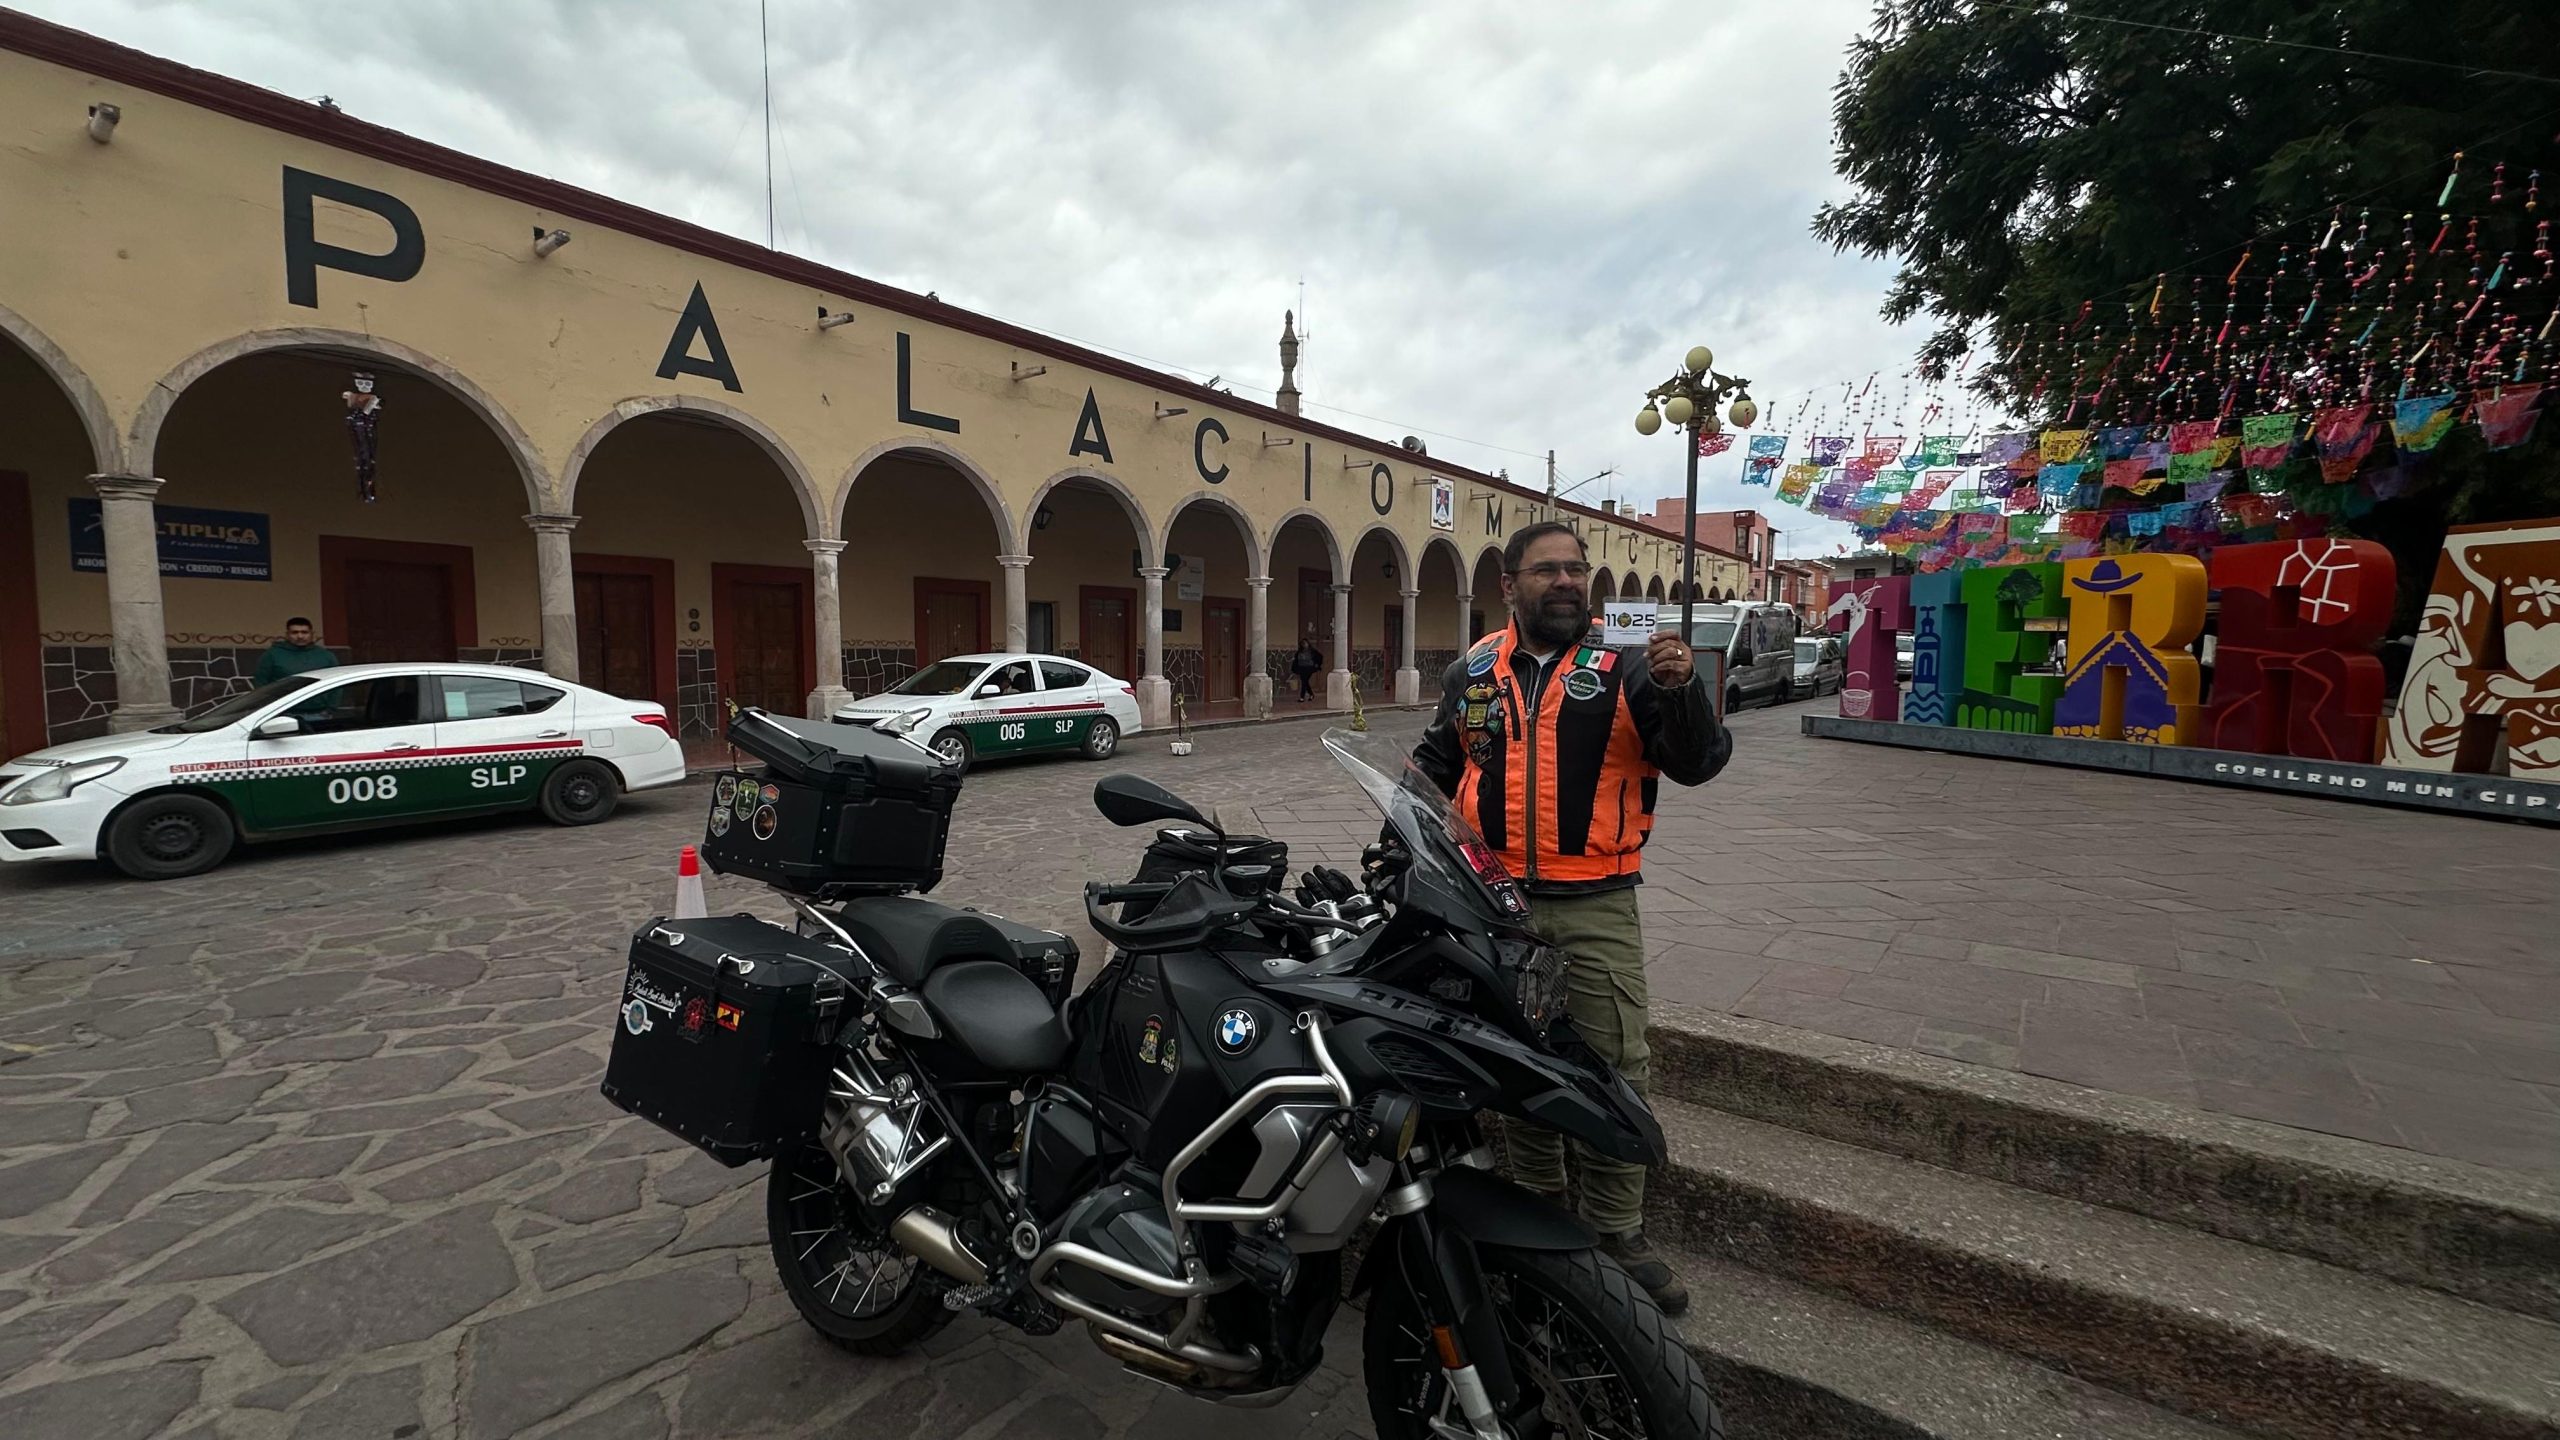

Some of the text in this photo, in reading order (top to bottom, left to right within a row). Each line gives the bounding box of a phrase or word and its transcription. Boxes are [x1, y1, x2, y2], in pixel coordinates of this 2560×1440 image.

[282, 164, 1393, 516] PALACIO
[1000, 723, 1025, 741] 005
[1055, 720, 1074, 733] SLP
[172, 757, 317, 773] SITIO JARDIN HIDALGO
[470, 765, 527, 788] SLP
[328, 774, 398, 804] 008
[1223, 1012, 1253, 1030] BMW
